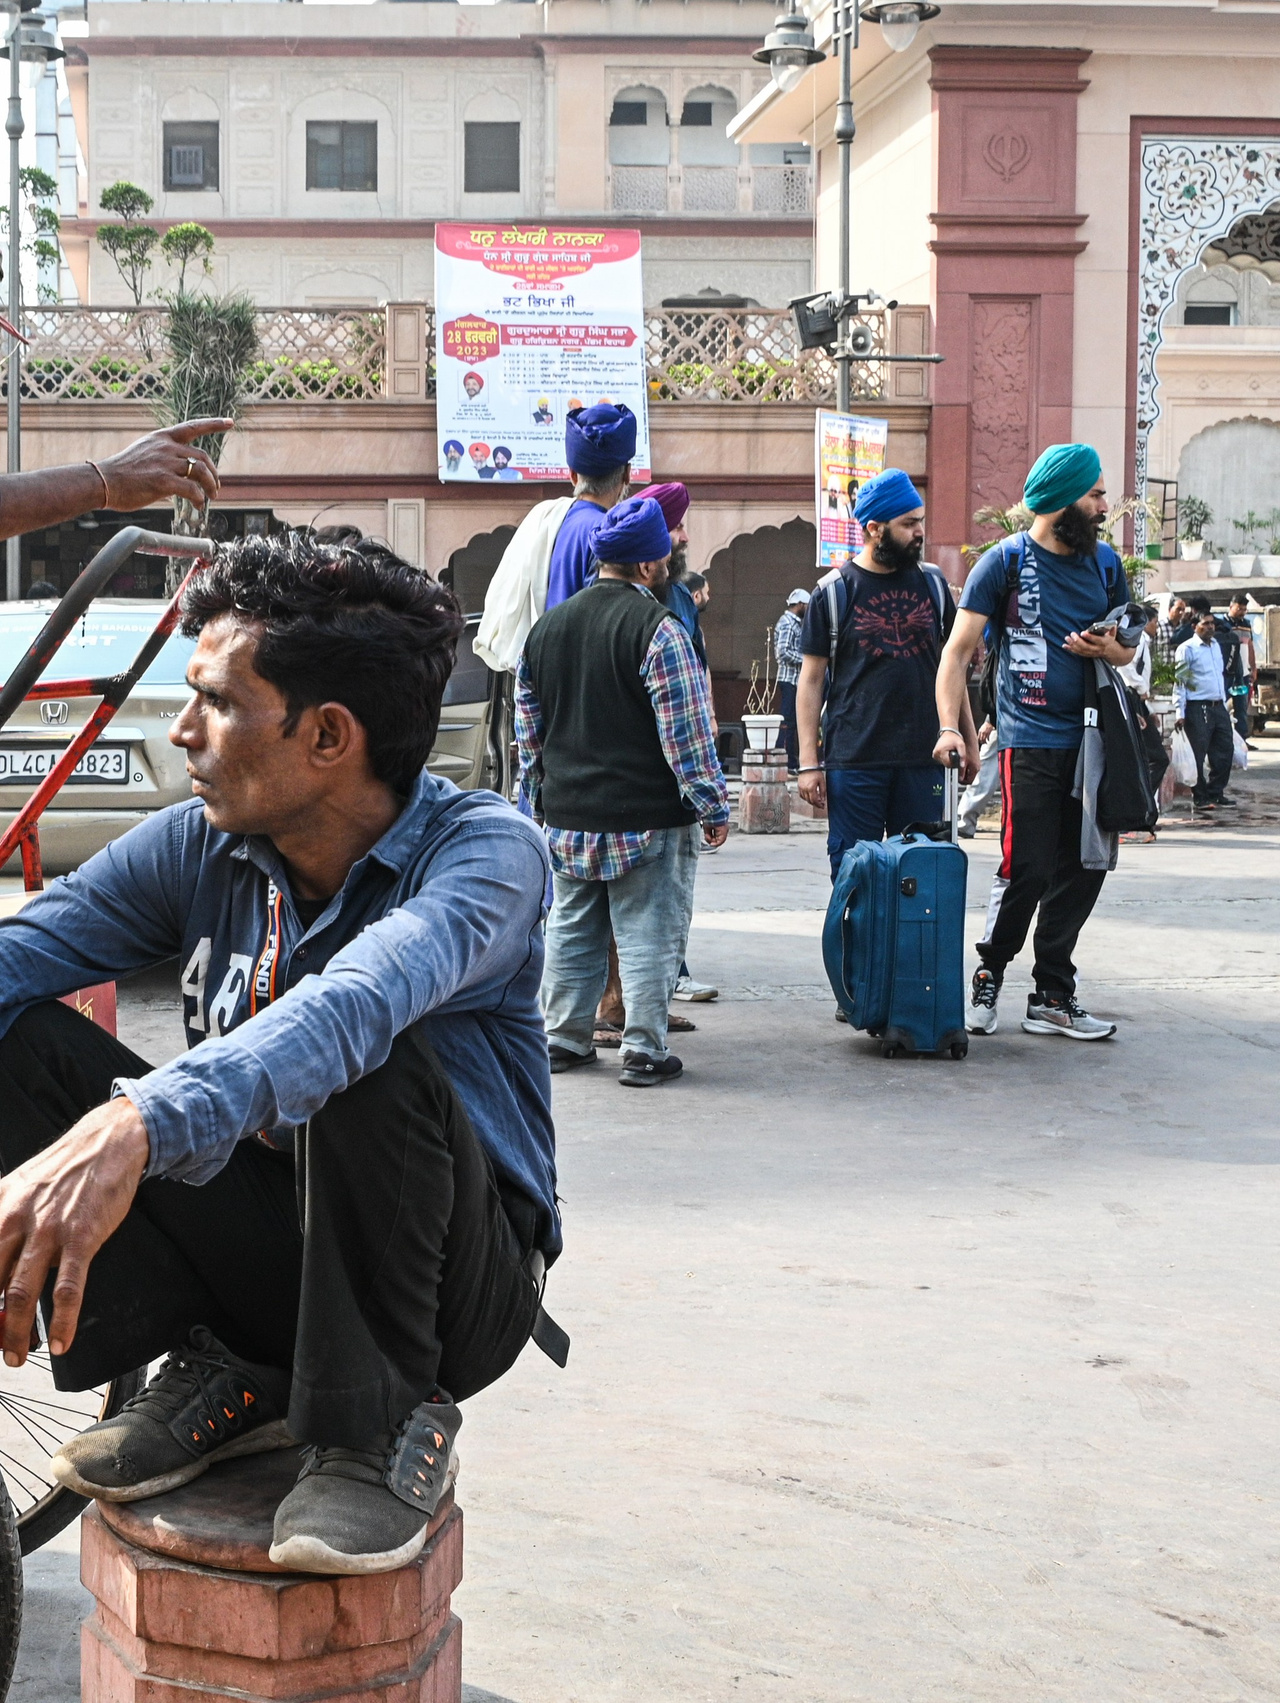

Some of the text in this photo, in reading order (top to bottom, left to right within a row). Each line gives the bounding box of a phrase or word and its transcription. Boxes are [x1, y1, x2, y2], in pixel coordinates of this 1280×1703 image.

[470, 226, 605, 248] ਧਨੁ ਲੇਖਾਰੀ ਨਾਨਕਾ
[503, 294, 576, 308] ਭਟ ਭਿਖਾ ਜੀ
[447, 330, 462, 344] 28
[457, 346, 488, 356] 2023
[868, 590, 919, 607] NAVAL
